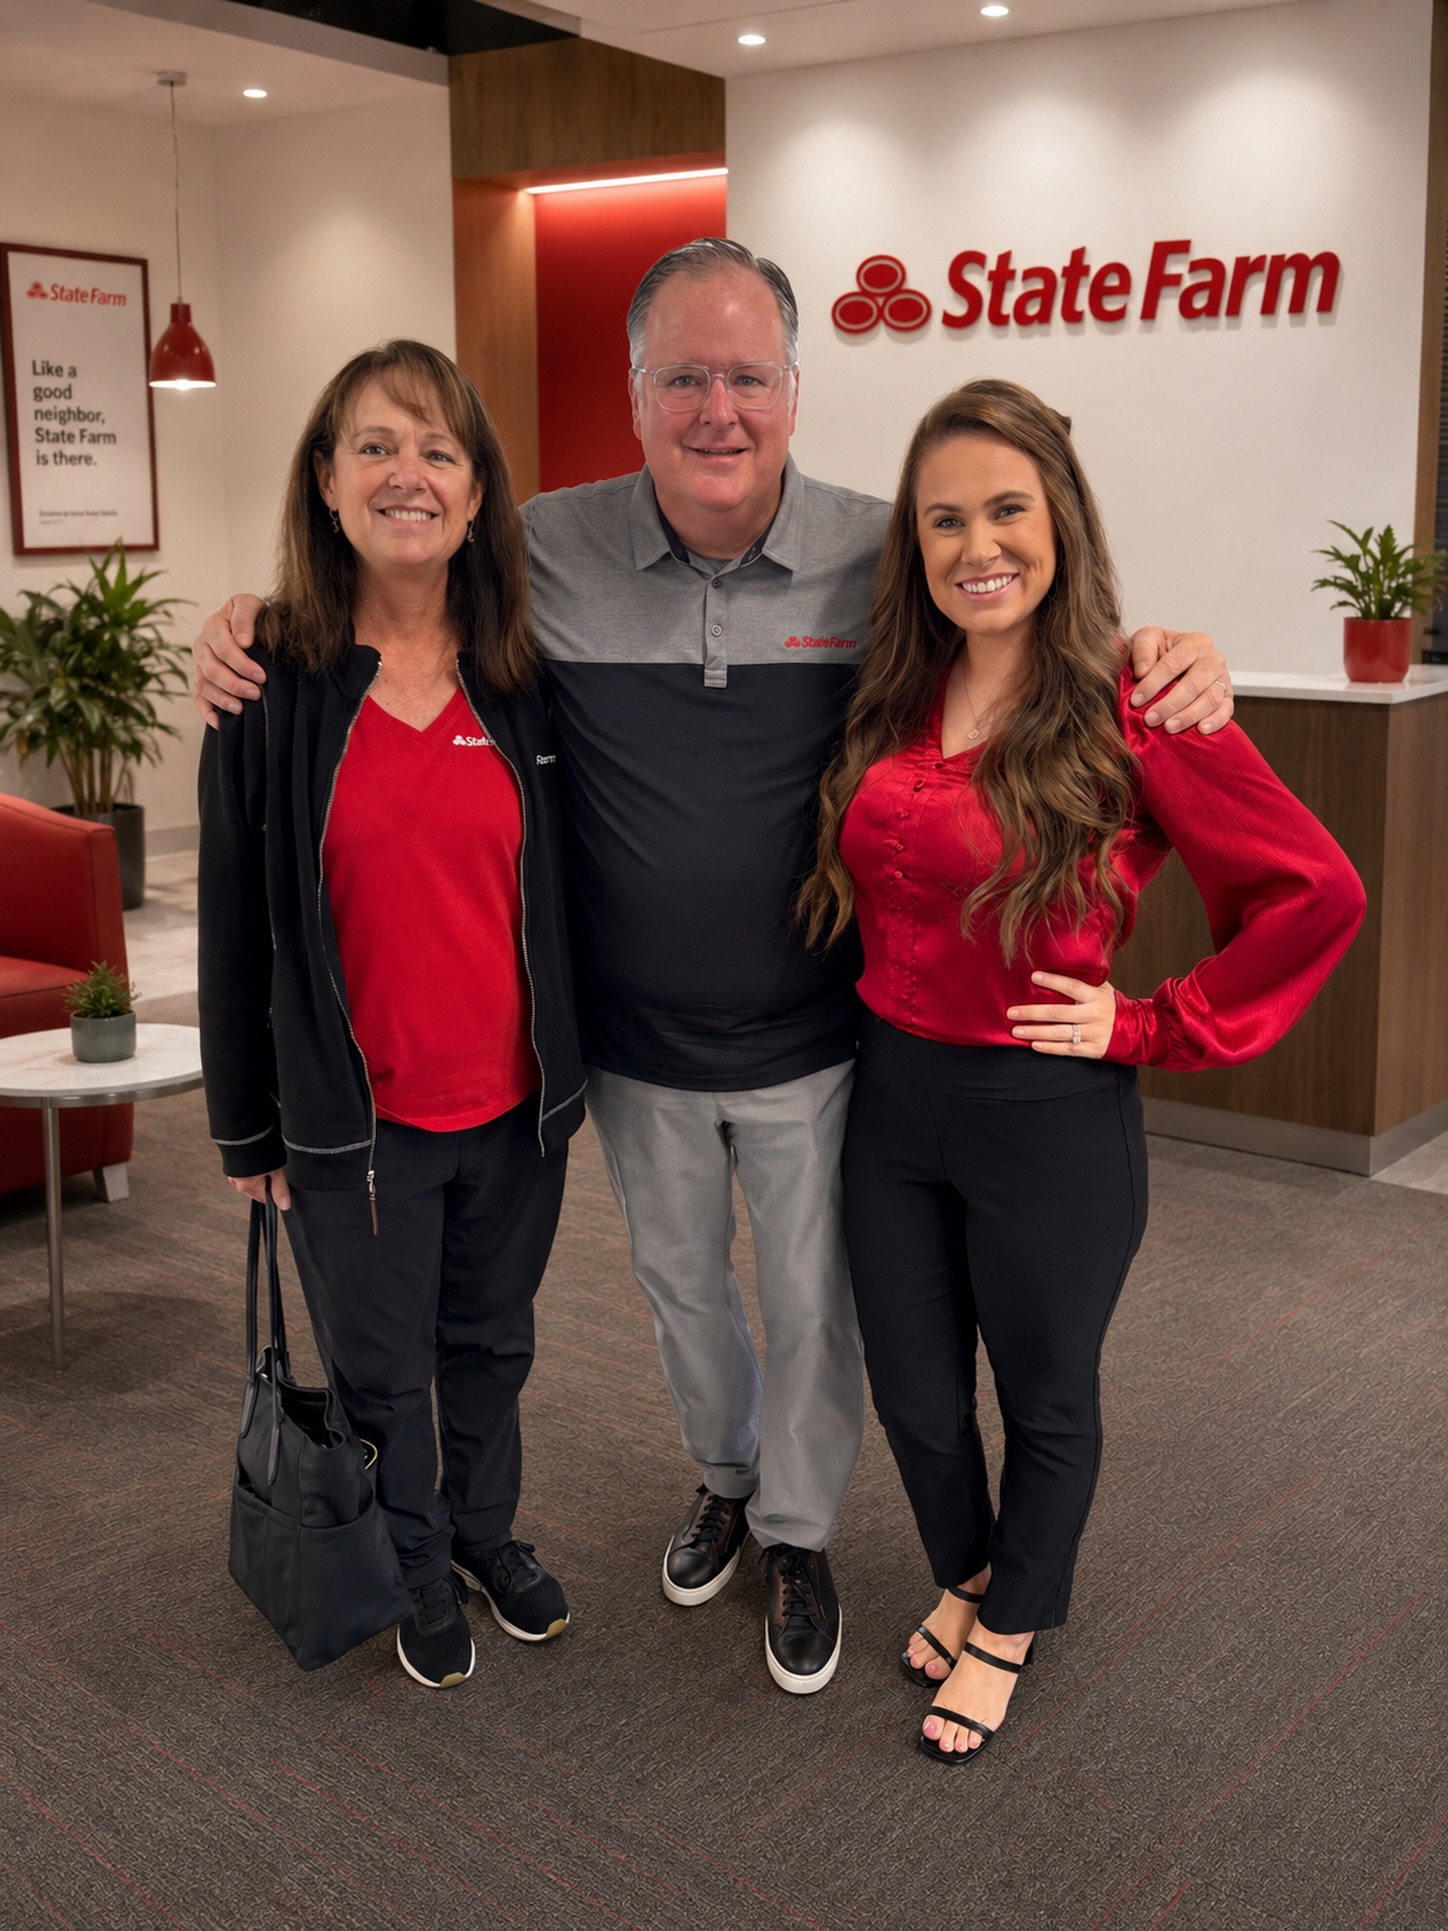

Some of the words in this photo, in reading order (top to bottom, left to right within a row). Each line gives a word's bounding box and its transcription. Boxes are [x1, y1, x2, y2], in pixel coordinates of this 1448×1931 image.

[942, 246, 1132, 329] State
[1140, 239, 1341, 321] Farm
[50, 283, 89, 304] State
[90, 287, 127, 306] Farm
[32, 360, 63, 377] Like
[67, 365, 77, 378] a
[33, 383, 72, 402] good
[34, 406, 105, 426] neighbor,
[35, 427, 76, 444] State
[79, 428, 117, 445] Farm
[36, 450, 48, 466] is
[53, 450, 97, 467] there.
